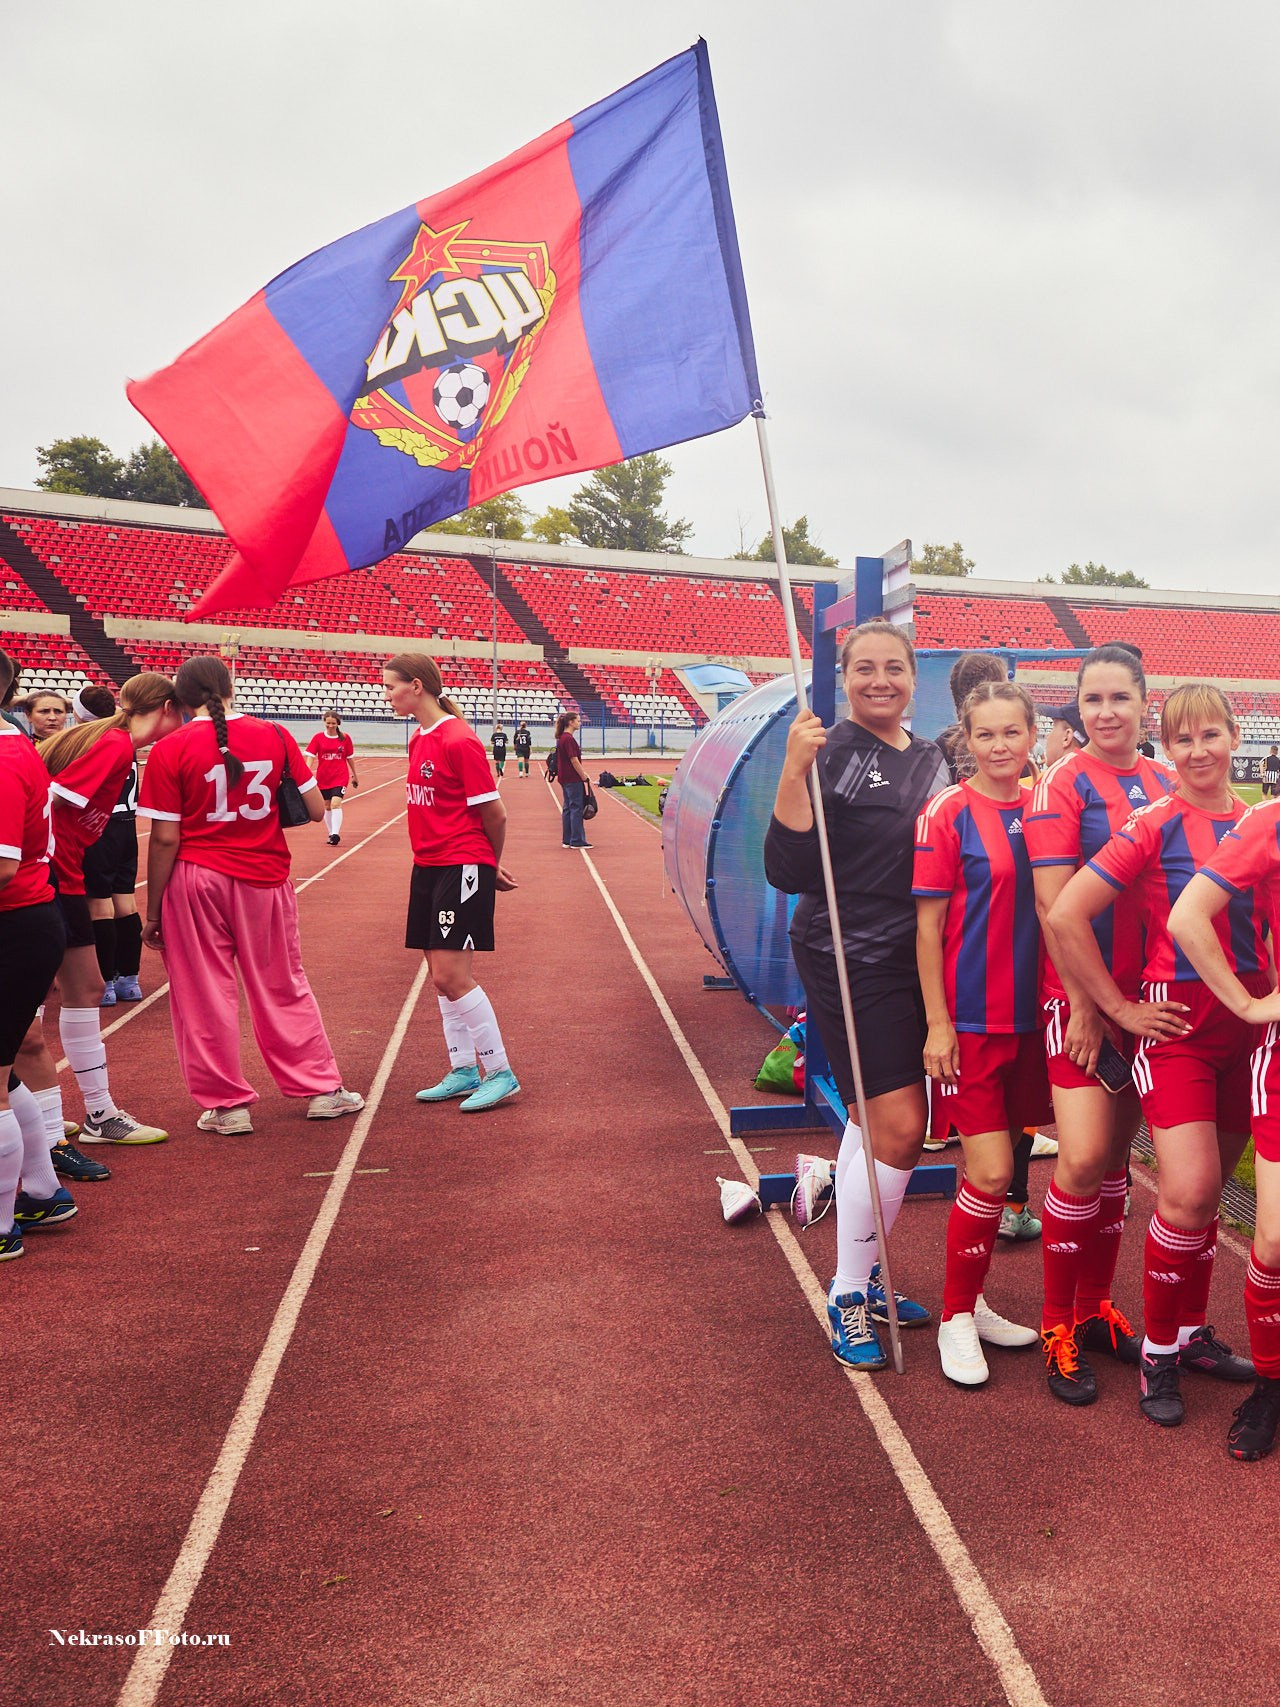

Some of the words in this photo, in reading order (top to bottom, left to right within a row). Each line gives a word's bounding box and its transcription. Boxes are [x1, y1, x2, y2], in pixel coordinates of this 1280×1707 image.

[869, 780, 891, 789] KELME
[204, 760, 274, 822] 13
[1008, 827, 1024, 835] adid
[438, 910, 456, 925] 63
[479, 1049, 494, 1057] AKO
